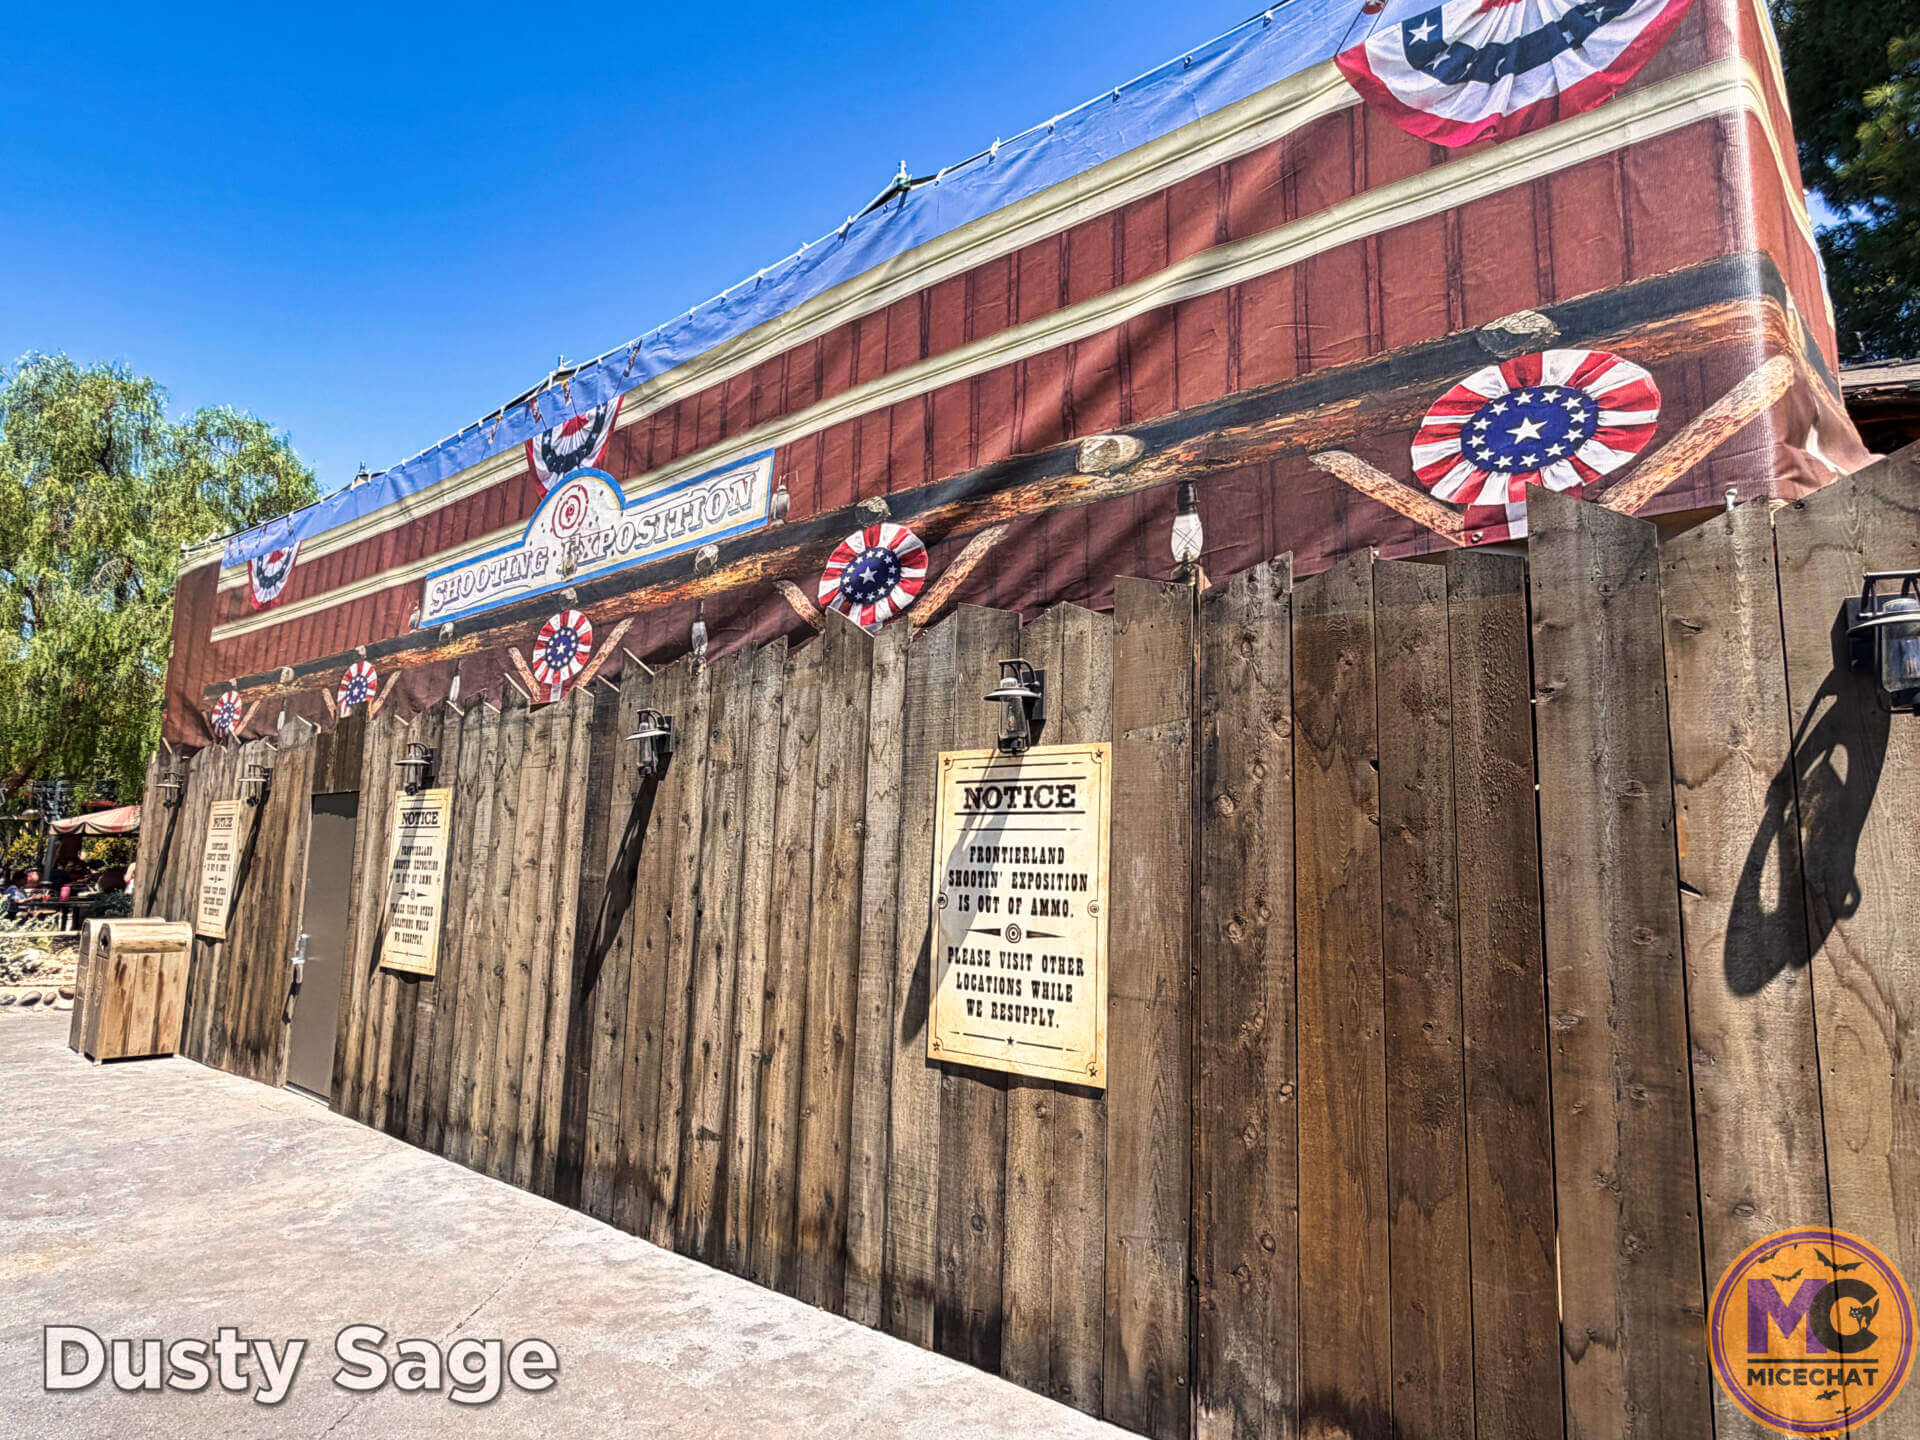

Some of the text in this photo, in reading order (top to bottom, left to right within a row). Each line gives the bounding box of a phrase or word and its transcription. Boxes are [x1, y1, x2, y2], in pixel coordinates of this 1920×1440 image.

[430, 546, 549, 616] SHOOTING
[963, 784, 1076, 810] NOTICE
[401, 811, 439, 825] NOTICE
[969, 846, 1065, 865] FRONTIERLAND
[948, 869, 1088, 891] SHOOTIN' EXPOSITION
[958, 894, 1074, 918] IS OUT OF AMMO.
[947, 946, 1084, 977] PLEASE VISIT OTHER
[956, 972, 1073, 1003] LOCATIONS WHILE
[966, 999, 1059, 1029] WE RESUPPLY.
